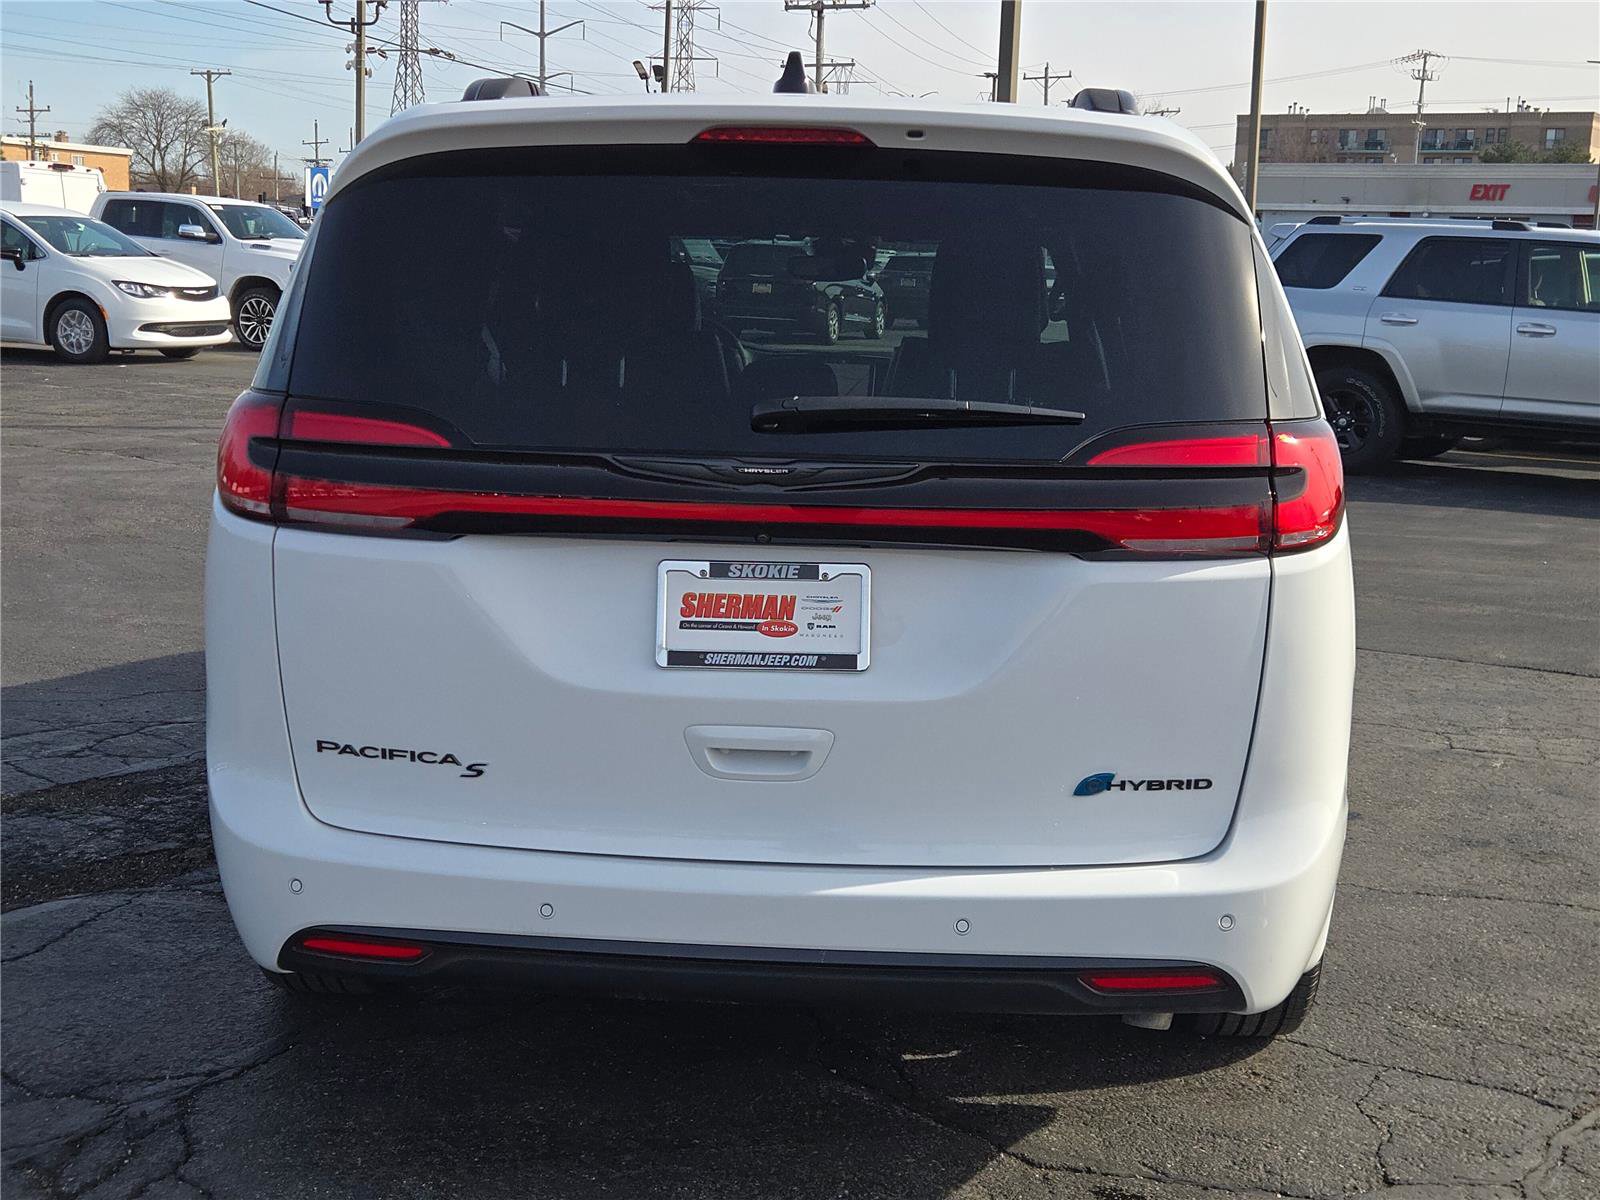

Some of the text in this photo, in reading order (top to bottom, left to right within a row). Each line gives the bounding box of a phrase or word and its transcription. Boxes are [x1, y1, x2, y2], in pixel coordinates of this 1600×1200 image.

[1469, 184, 1511, 201] EXIT
[728, 564, 800, 579] SKOKIE
[680, 591, 797, 621] SHERMAN
[812, 612, 832, 622] Jeep
[761, 624, 795, 633] In Skokie
[704, 653, 819, 667] SHERMANJEEP.COM
[316, 740, 489, 778] PACIFICA S
